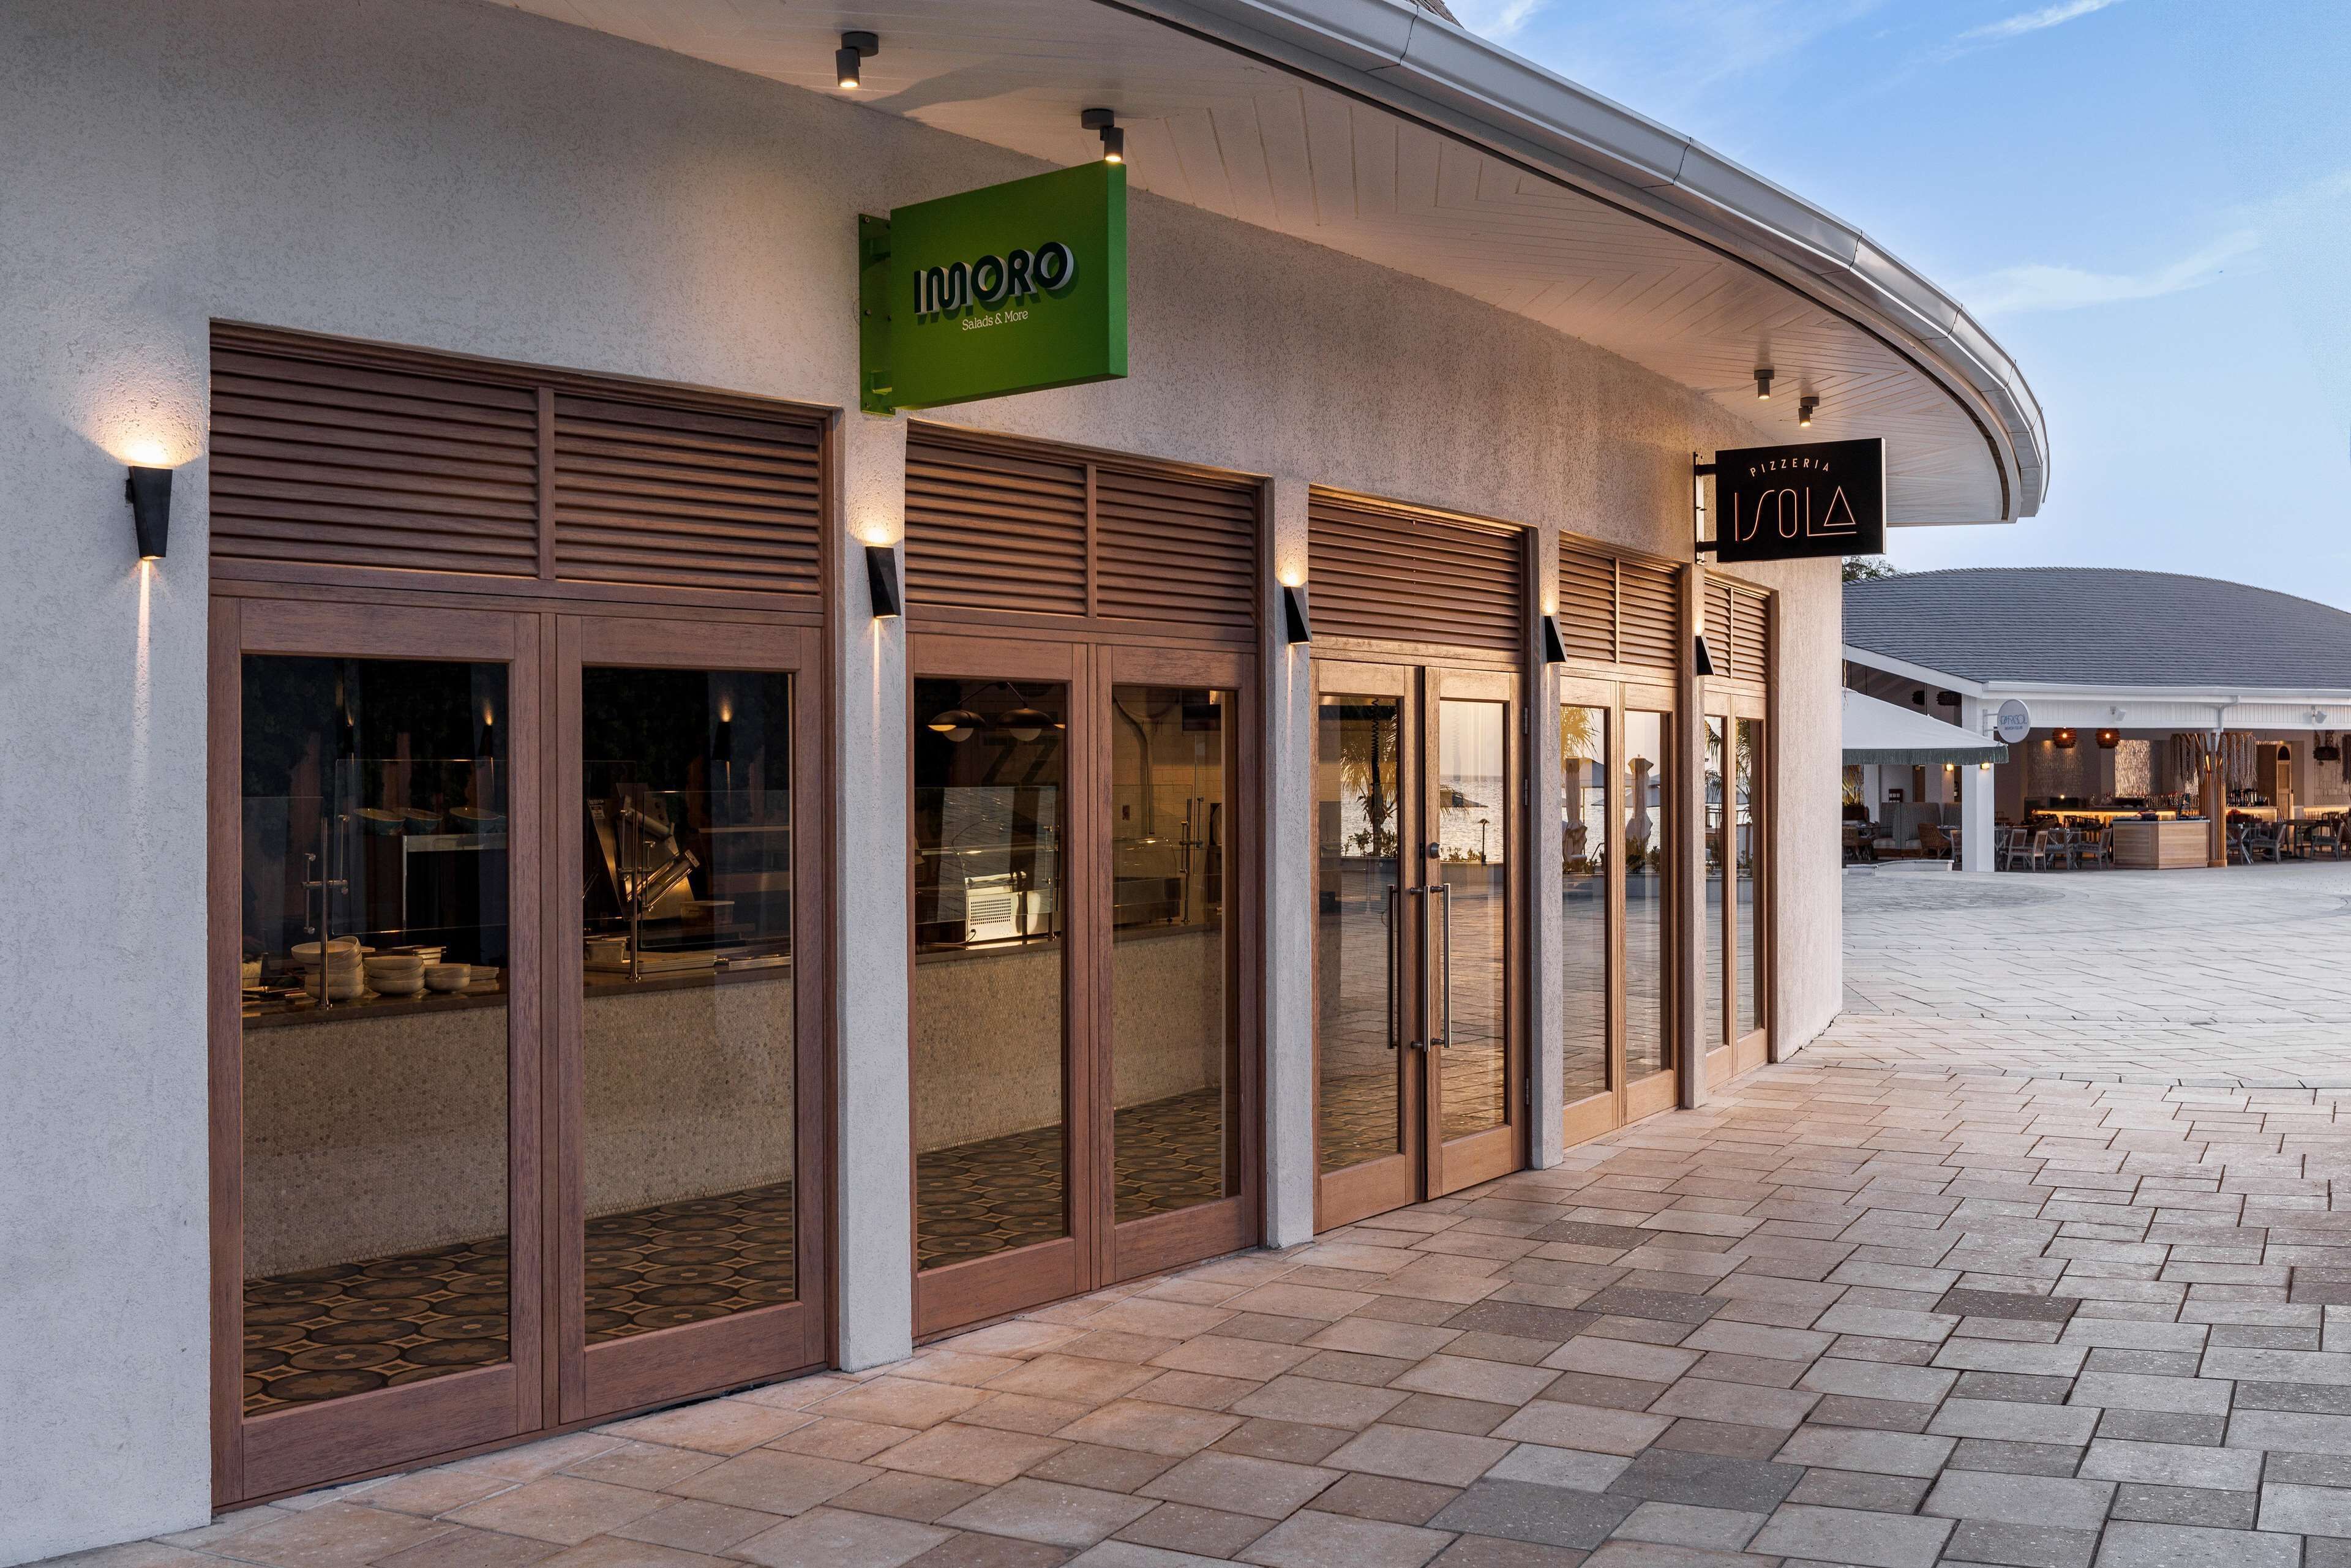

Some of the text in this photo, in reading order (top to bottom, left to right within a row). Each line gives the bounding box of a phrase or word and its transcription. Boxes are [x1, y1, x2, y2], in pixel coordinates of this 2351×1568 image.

[962, 310, 1029, 331] Salads & More
[1749, 458, 1829, 477] PIZZERIA
[1734, 486, 1857, 542] ISOLA
